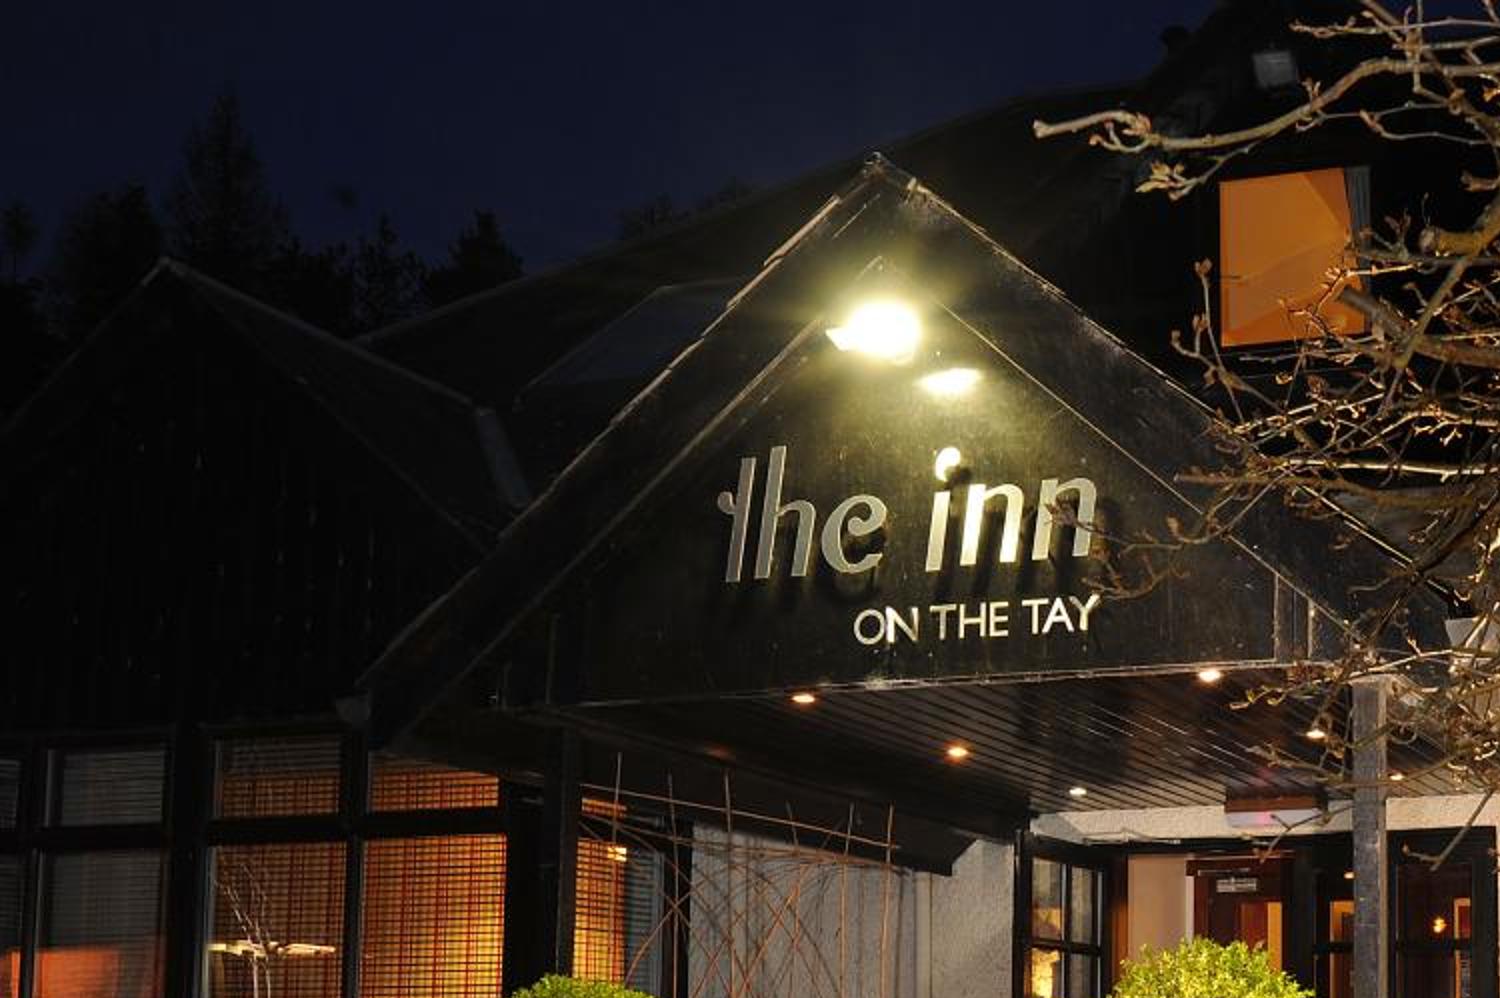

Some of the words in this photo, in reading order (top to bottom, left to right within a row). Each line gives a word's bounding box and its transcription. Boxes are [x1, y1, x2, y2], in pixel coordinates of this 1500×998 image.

[717, 445, 888, 583] the
[924, 446, 1098, 573] inn
[853, 606, 920, 646] ON
[930, 601, 1010, 640] THE
[1022, 595, 1100, 636] TAY
